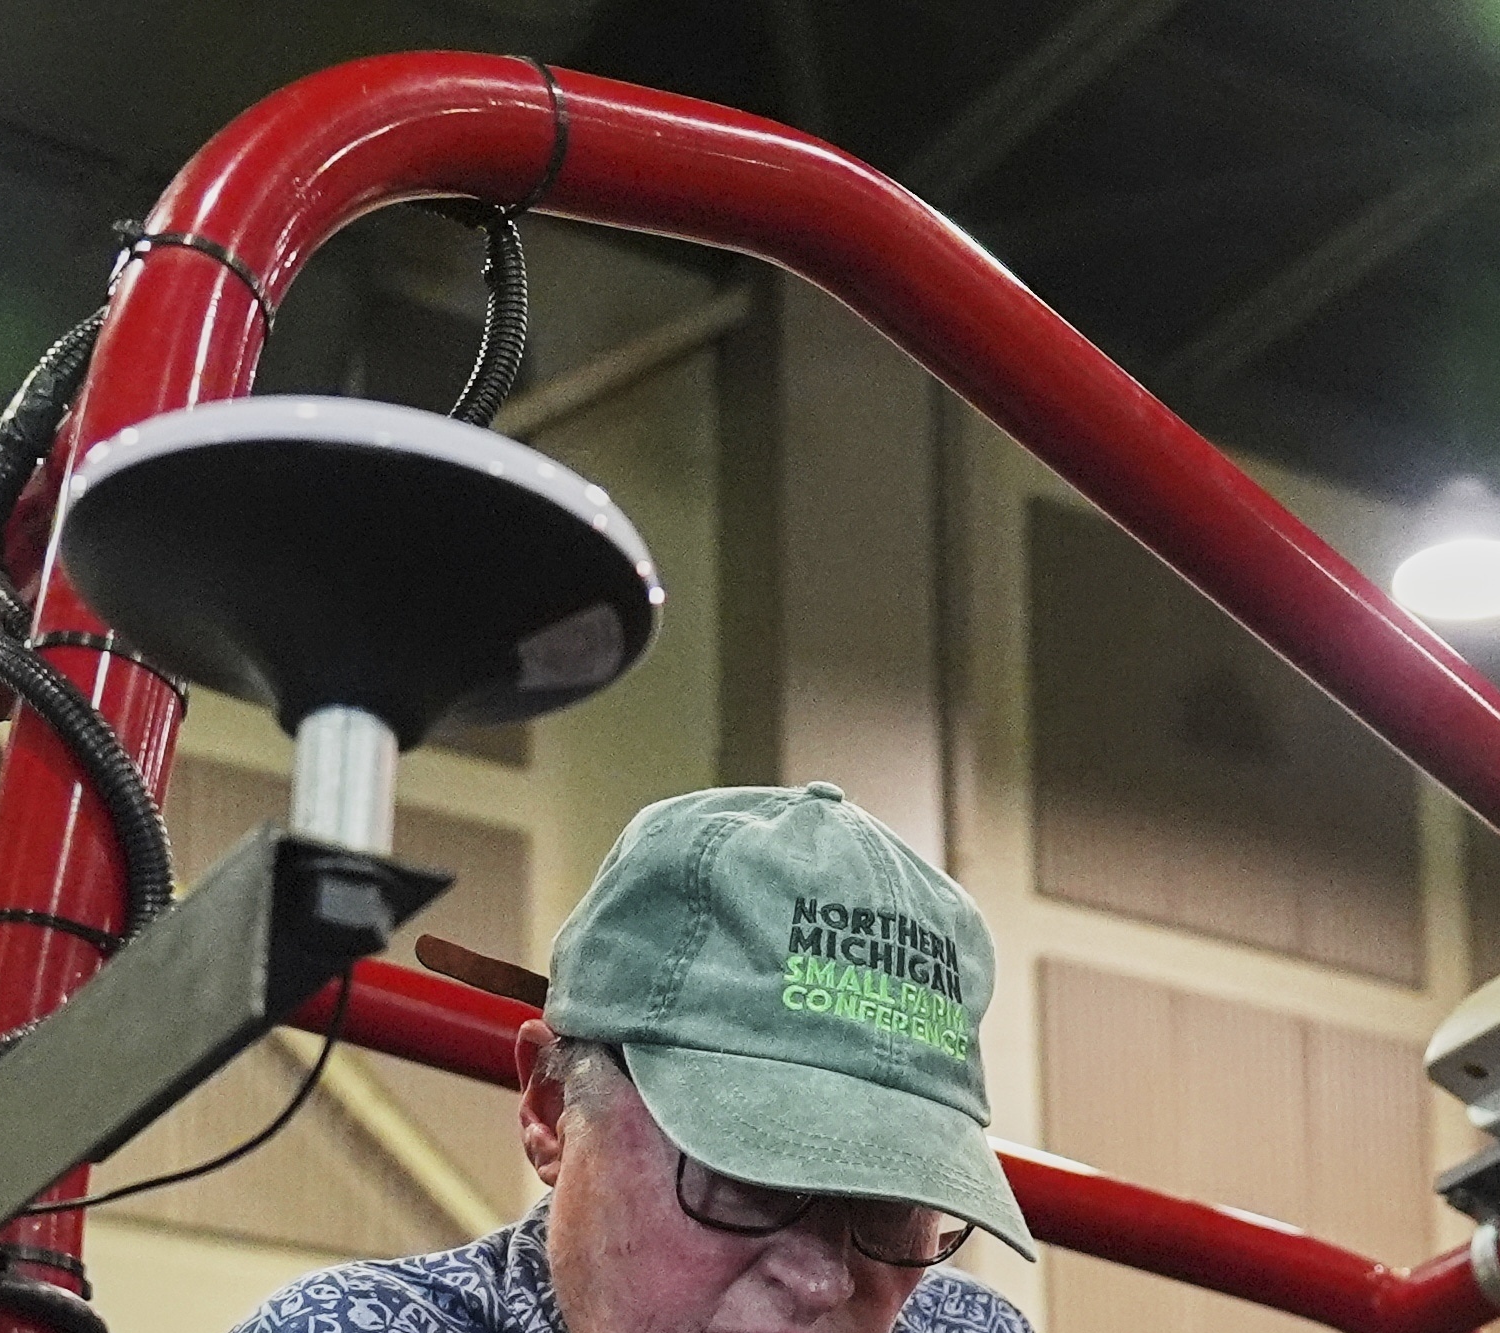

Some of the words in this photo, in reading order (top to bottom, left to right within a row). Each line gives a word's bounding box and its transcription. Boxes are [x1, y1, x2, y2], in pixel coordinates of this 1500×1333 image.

[788, 926, 963, 1004] MICHIGAN
[792, 897, 960, 974] NORTHERN
[782, 985, 968, 1061] CONFERENCE
[783, 956, 896, 1005] SMALL
[901, 982, 965, 1032] FARM
